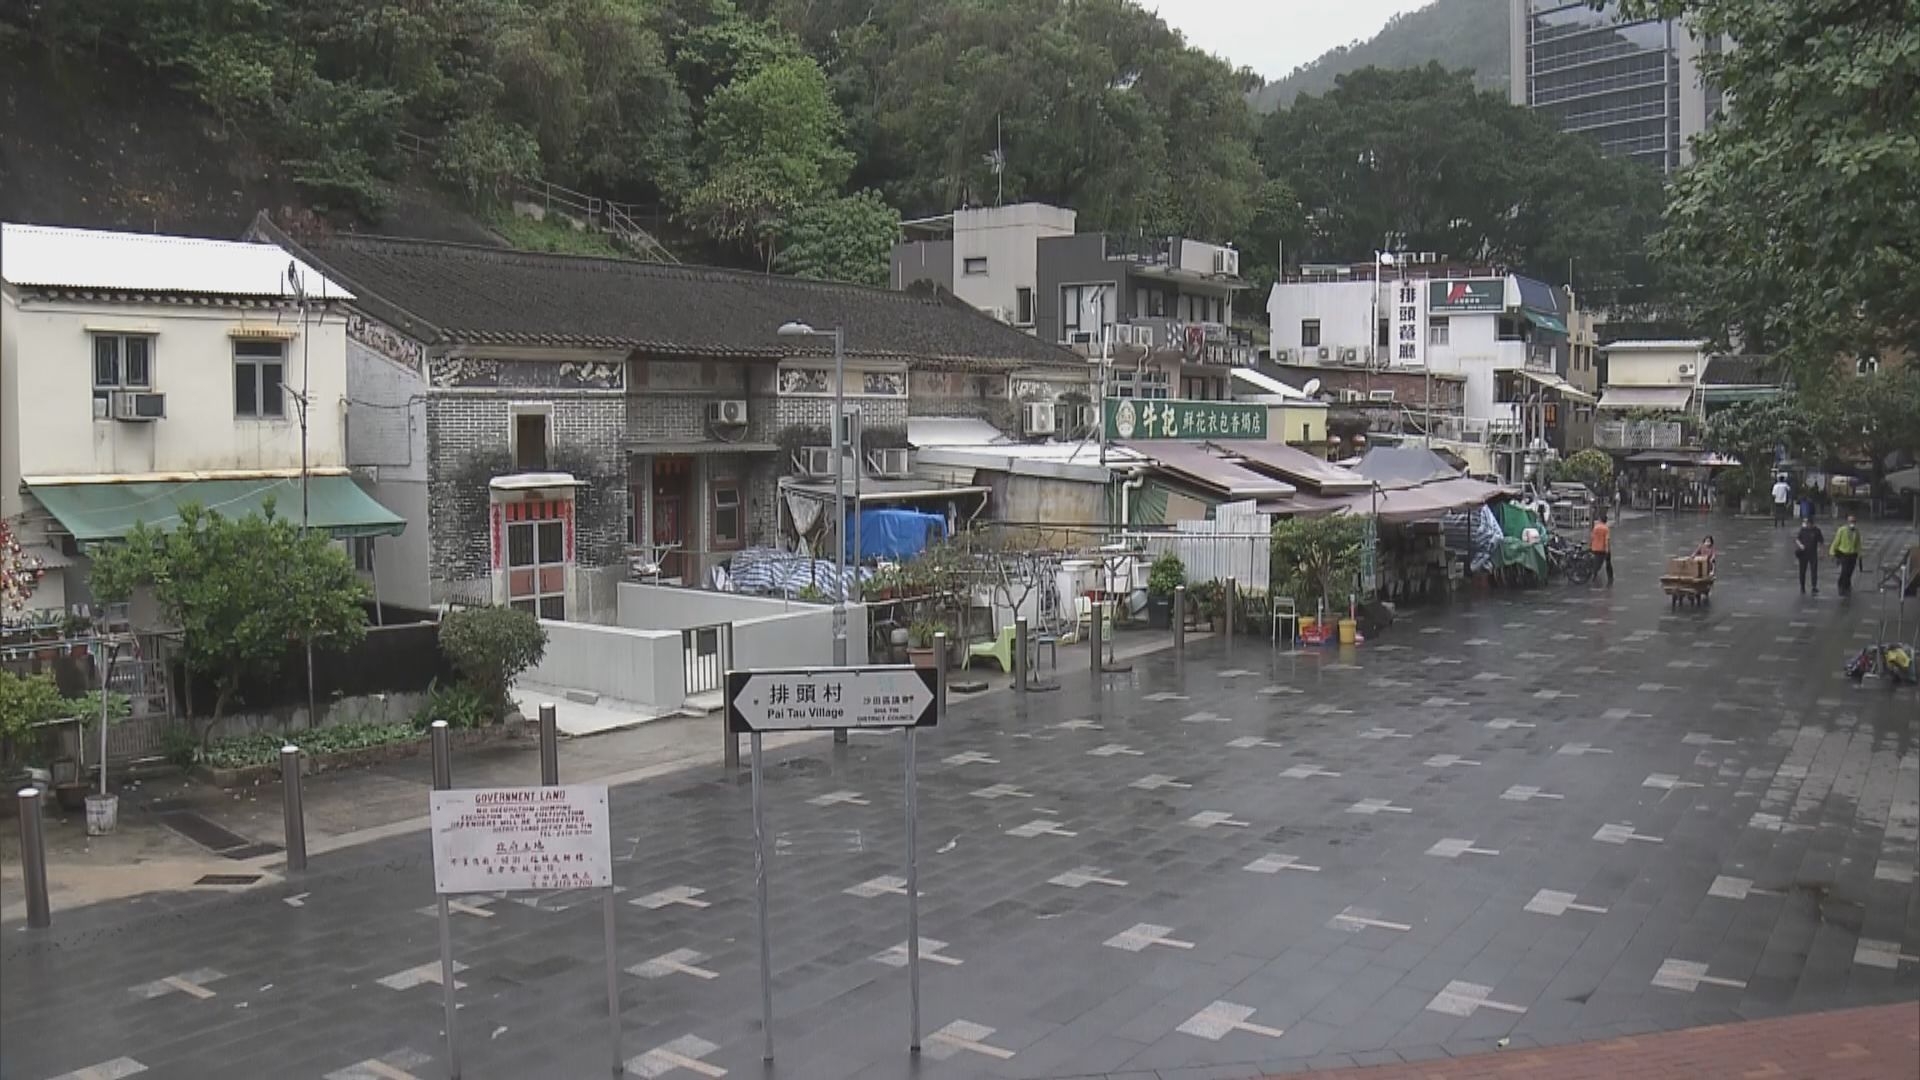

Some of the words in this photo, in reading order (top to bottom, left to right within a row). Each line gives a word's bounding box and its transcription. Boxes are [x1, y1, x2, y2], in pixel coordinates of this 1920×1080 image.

[1142, 401, 1178, 437] 牛記
[769, 683, 842, 704] 排頭村
[767, 708, 784, 719] Pai
[787, 708, 806, 718] Tau
[808, 706, 844, 718] Village
[475, 791, 535, 804] GOVERNMENT
[540, 790, 566, 801] LAND
